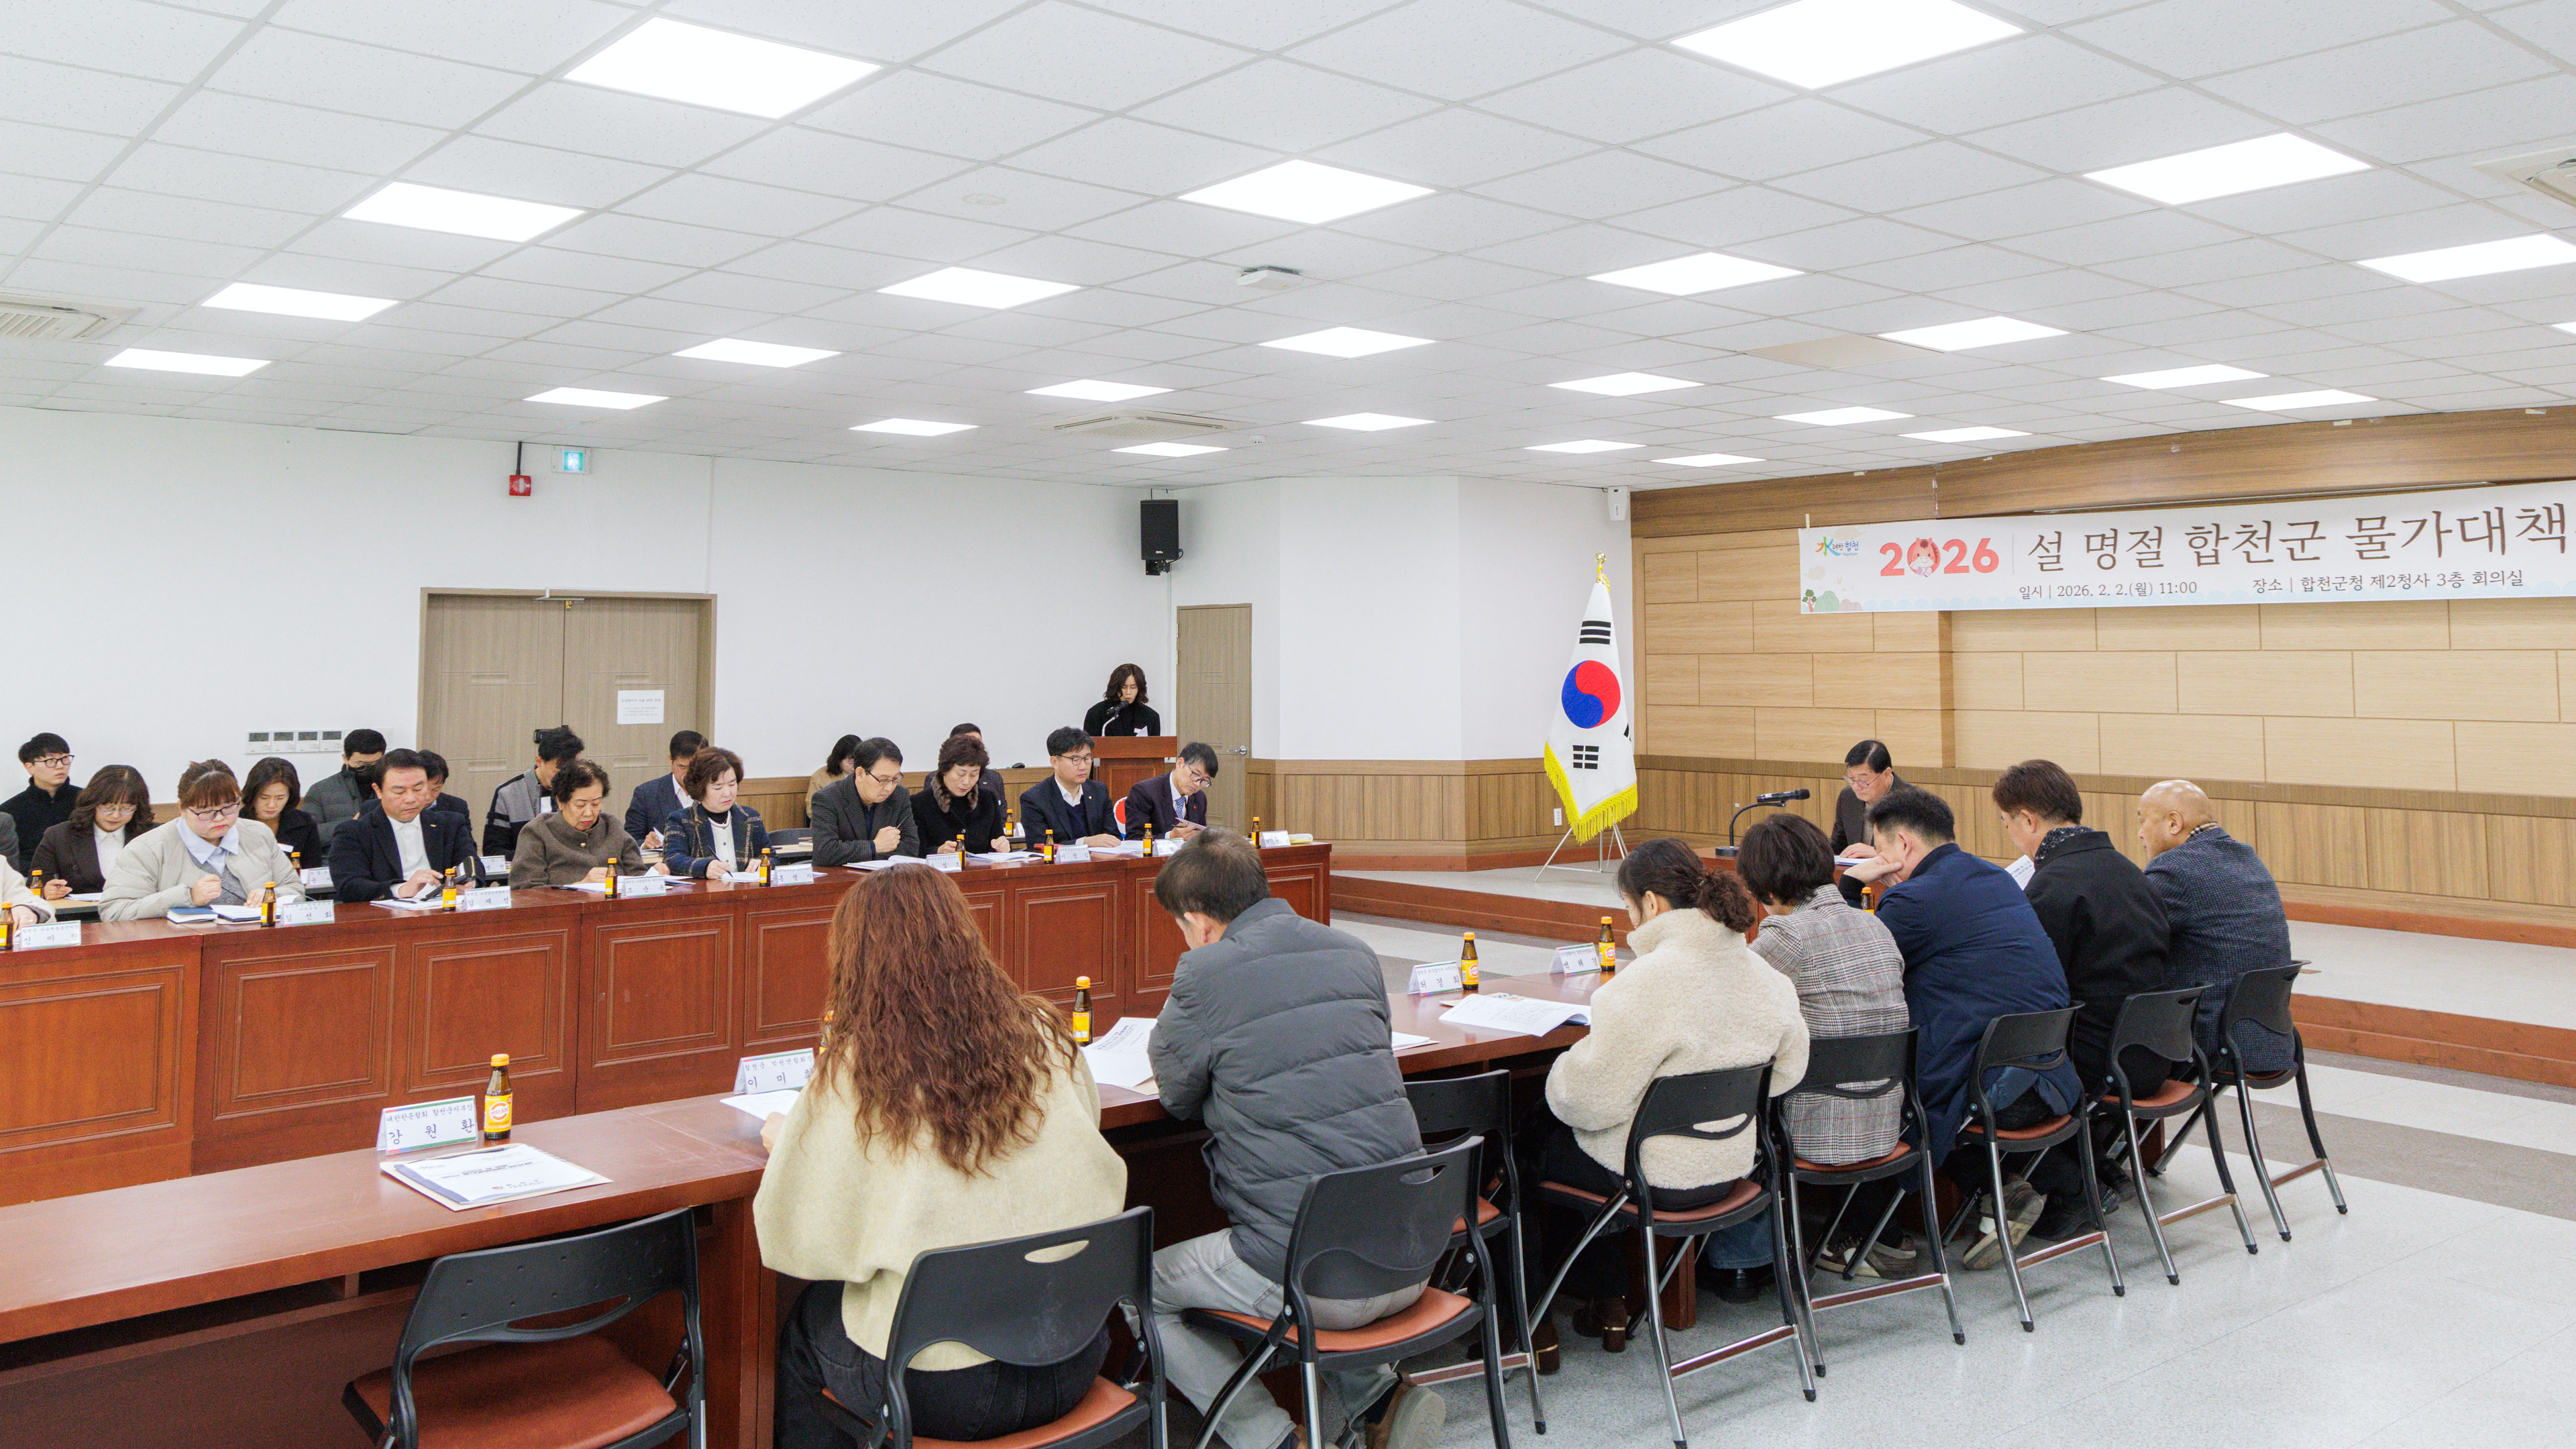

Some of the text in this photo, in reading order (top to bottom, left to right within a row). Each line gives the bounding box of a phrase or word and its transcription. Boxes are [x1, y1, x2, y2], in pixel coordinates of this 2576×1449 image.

[1845, 541, 1859, 551] 합천
[1880, 502, 2576, 578] 2026 설 명절 합천군 물가대책
[2019, 585, 2042, 600] 일시
[2057, 584, 2093, 597] 2026.
[2098, 584, 2110, 596] 2.
[2159, 581, 2198, 594] 11:00
[2253, 570, 2524, 594] 장소 합천군청 제2청사 3층 회의실
[747, 1075, 758, 1089] 이
[776, 1071, 786, 1085] 미
[386, 1103, 474, 1122] 대한한돈협회 합천군지부장
[388, 1118, 475, 1145] 강 원 환
